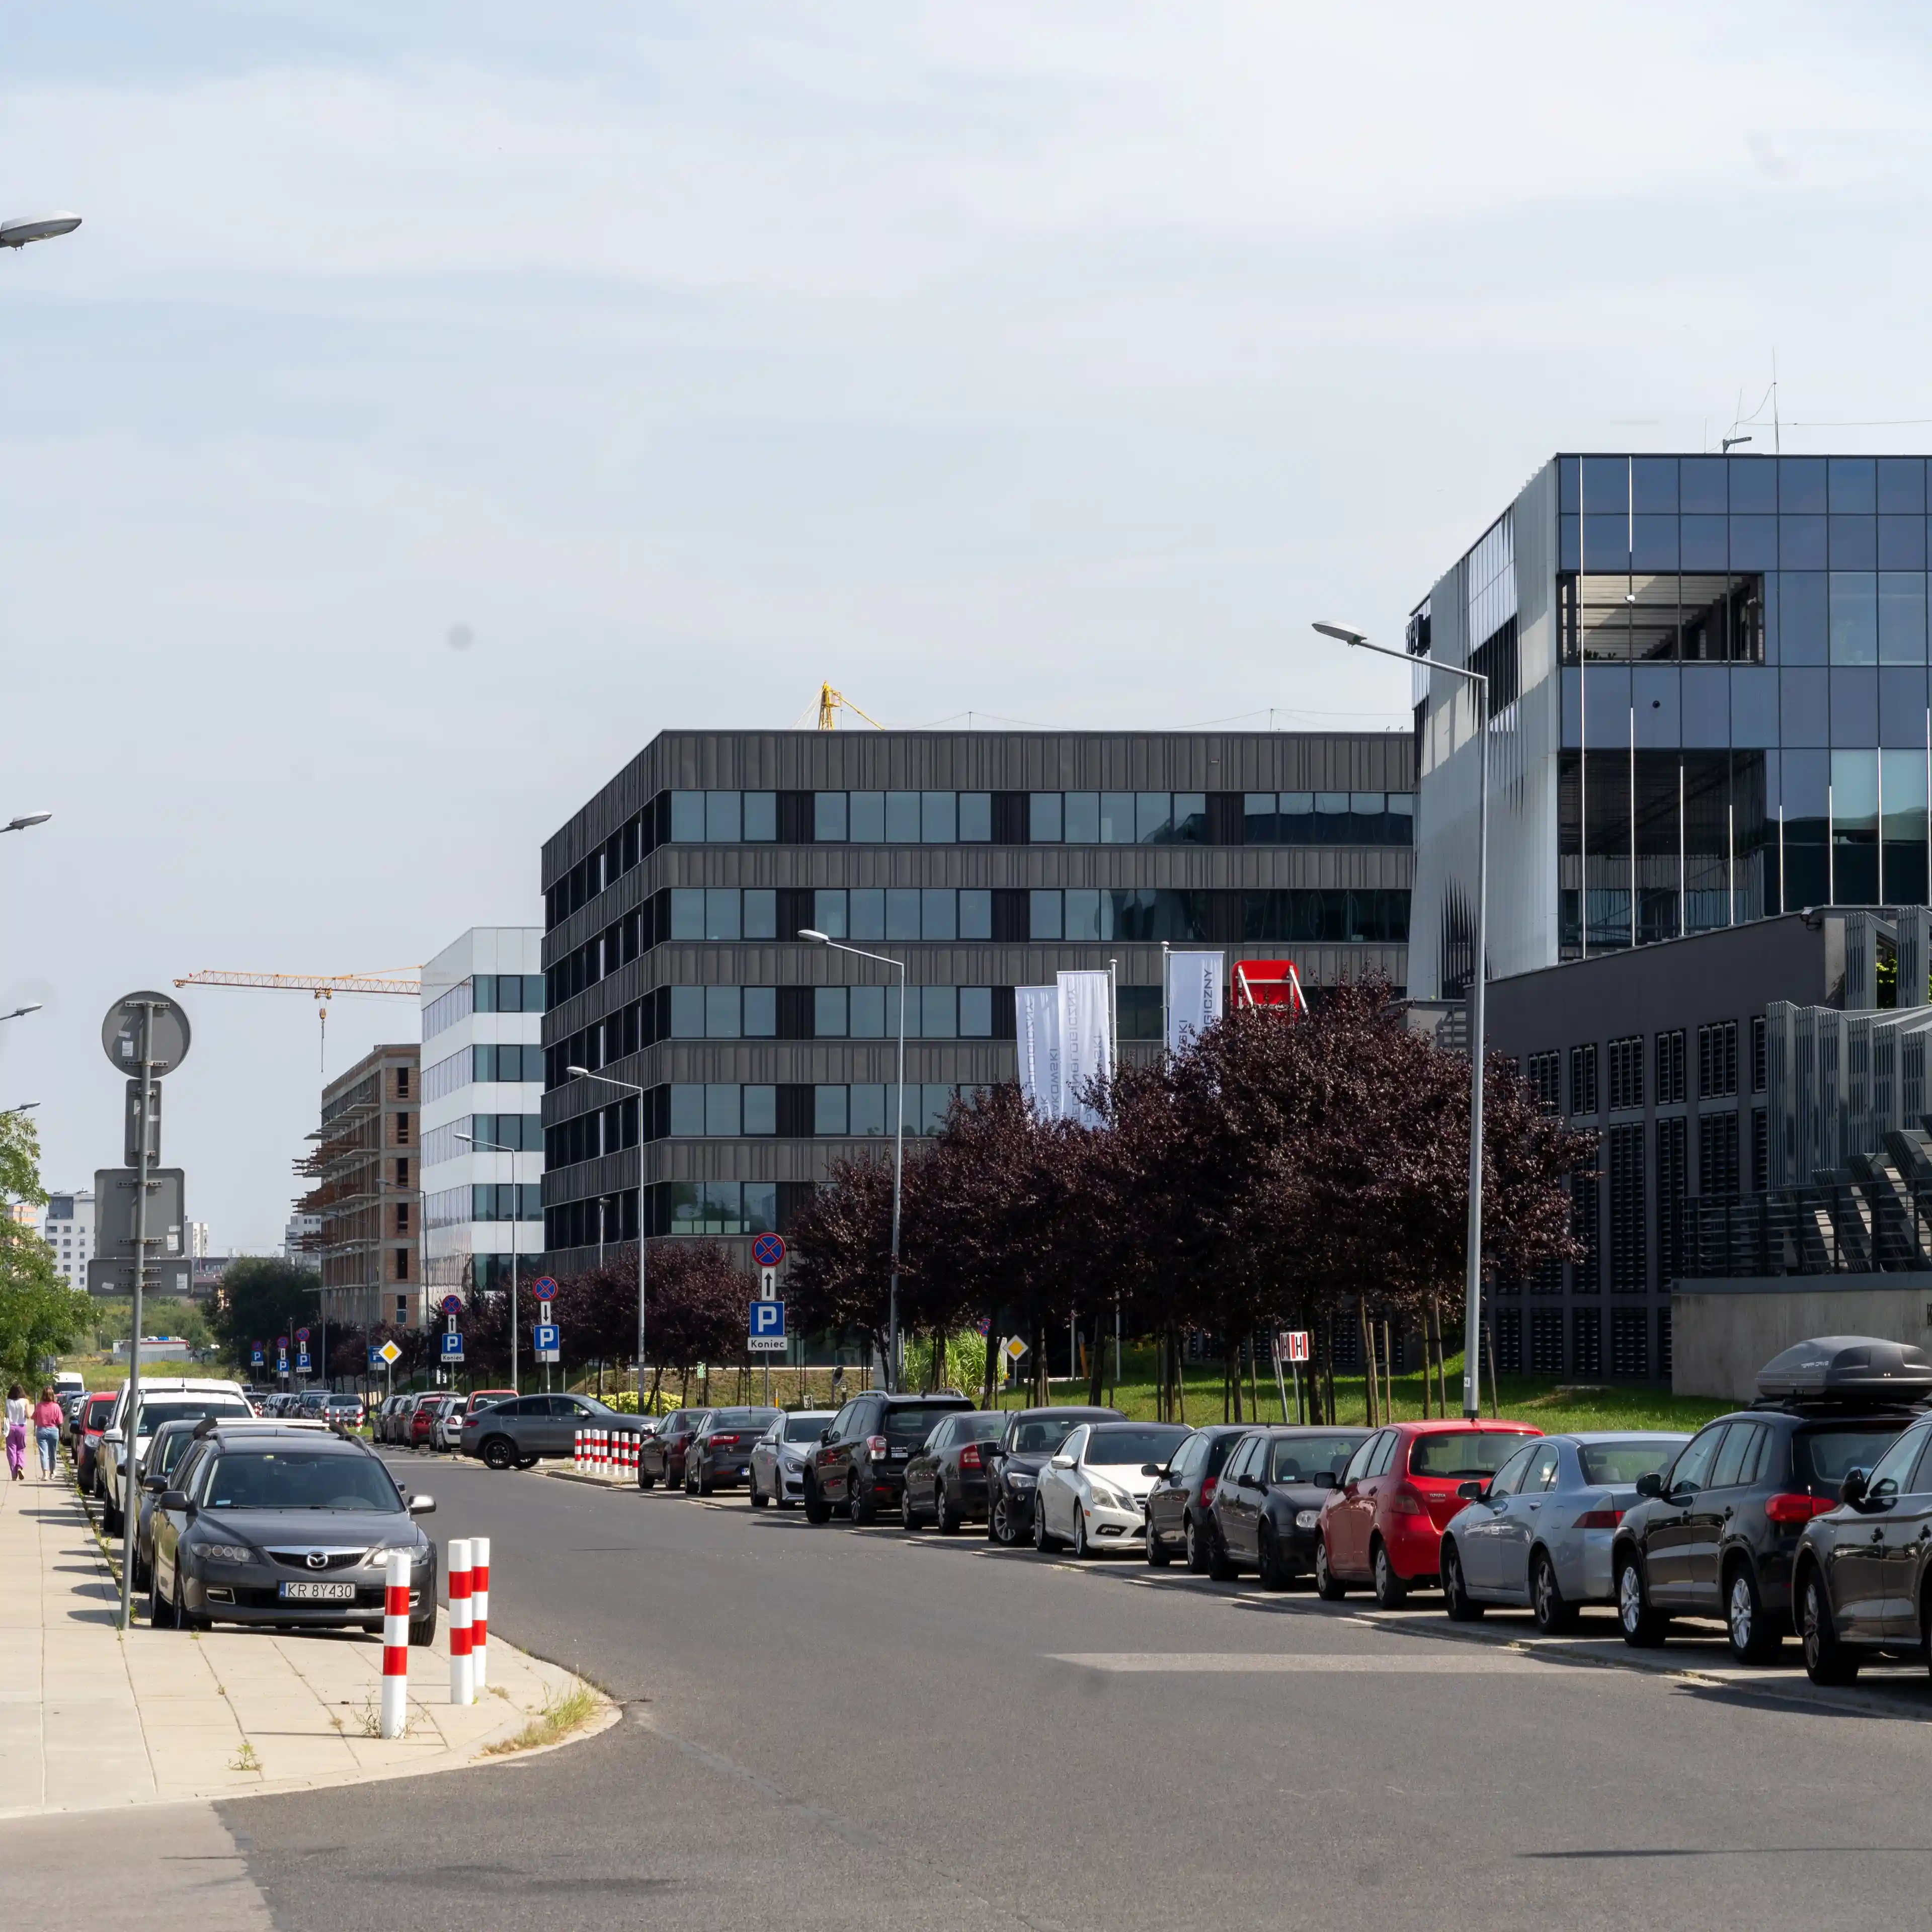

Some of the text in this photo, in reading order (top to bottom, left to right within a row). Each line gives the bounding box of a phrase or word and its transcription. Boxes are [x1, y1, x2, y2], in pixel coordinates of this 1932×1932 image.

[1203, 969, 1213, 1025] GICZNY
[758, 1306, 776, 1332] P
[447, 1336, 458, 1351] P
[540, 1328, 554, 1347] P
[751, 1339, 784, 1348] Koniec
[1296, 1336, 1303, 1356] H
[254, 1352, 261, 1360] P
[300, 1355, 307, 1365] P
[280, 1361, 287, 1371] P
[288, 1583, 352, 1598] KR 8Y430
